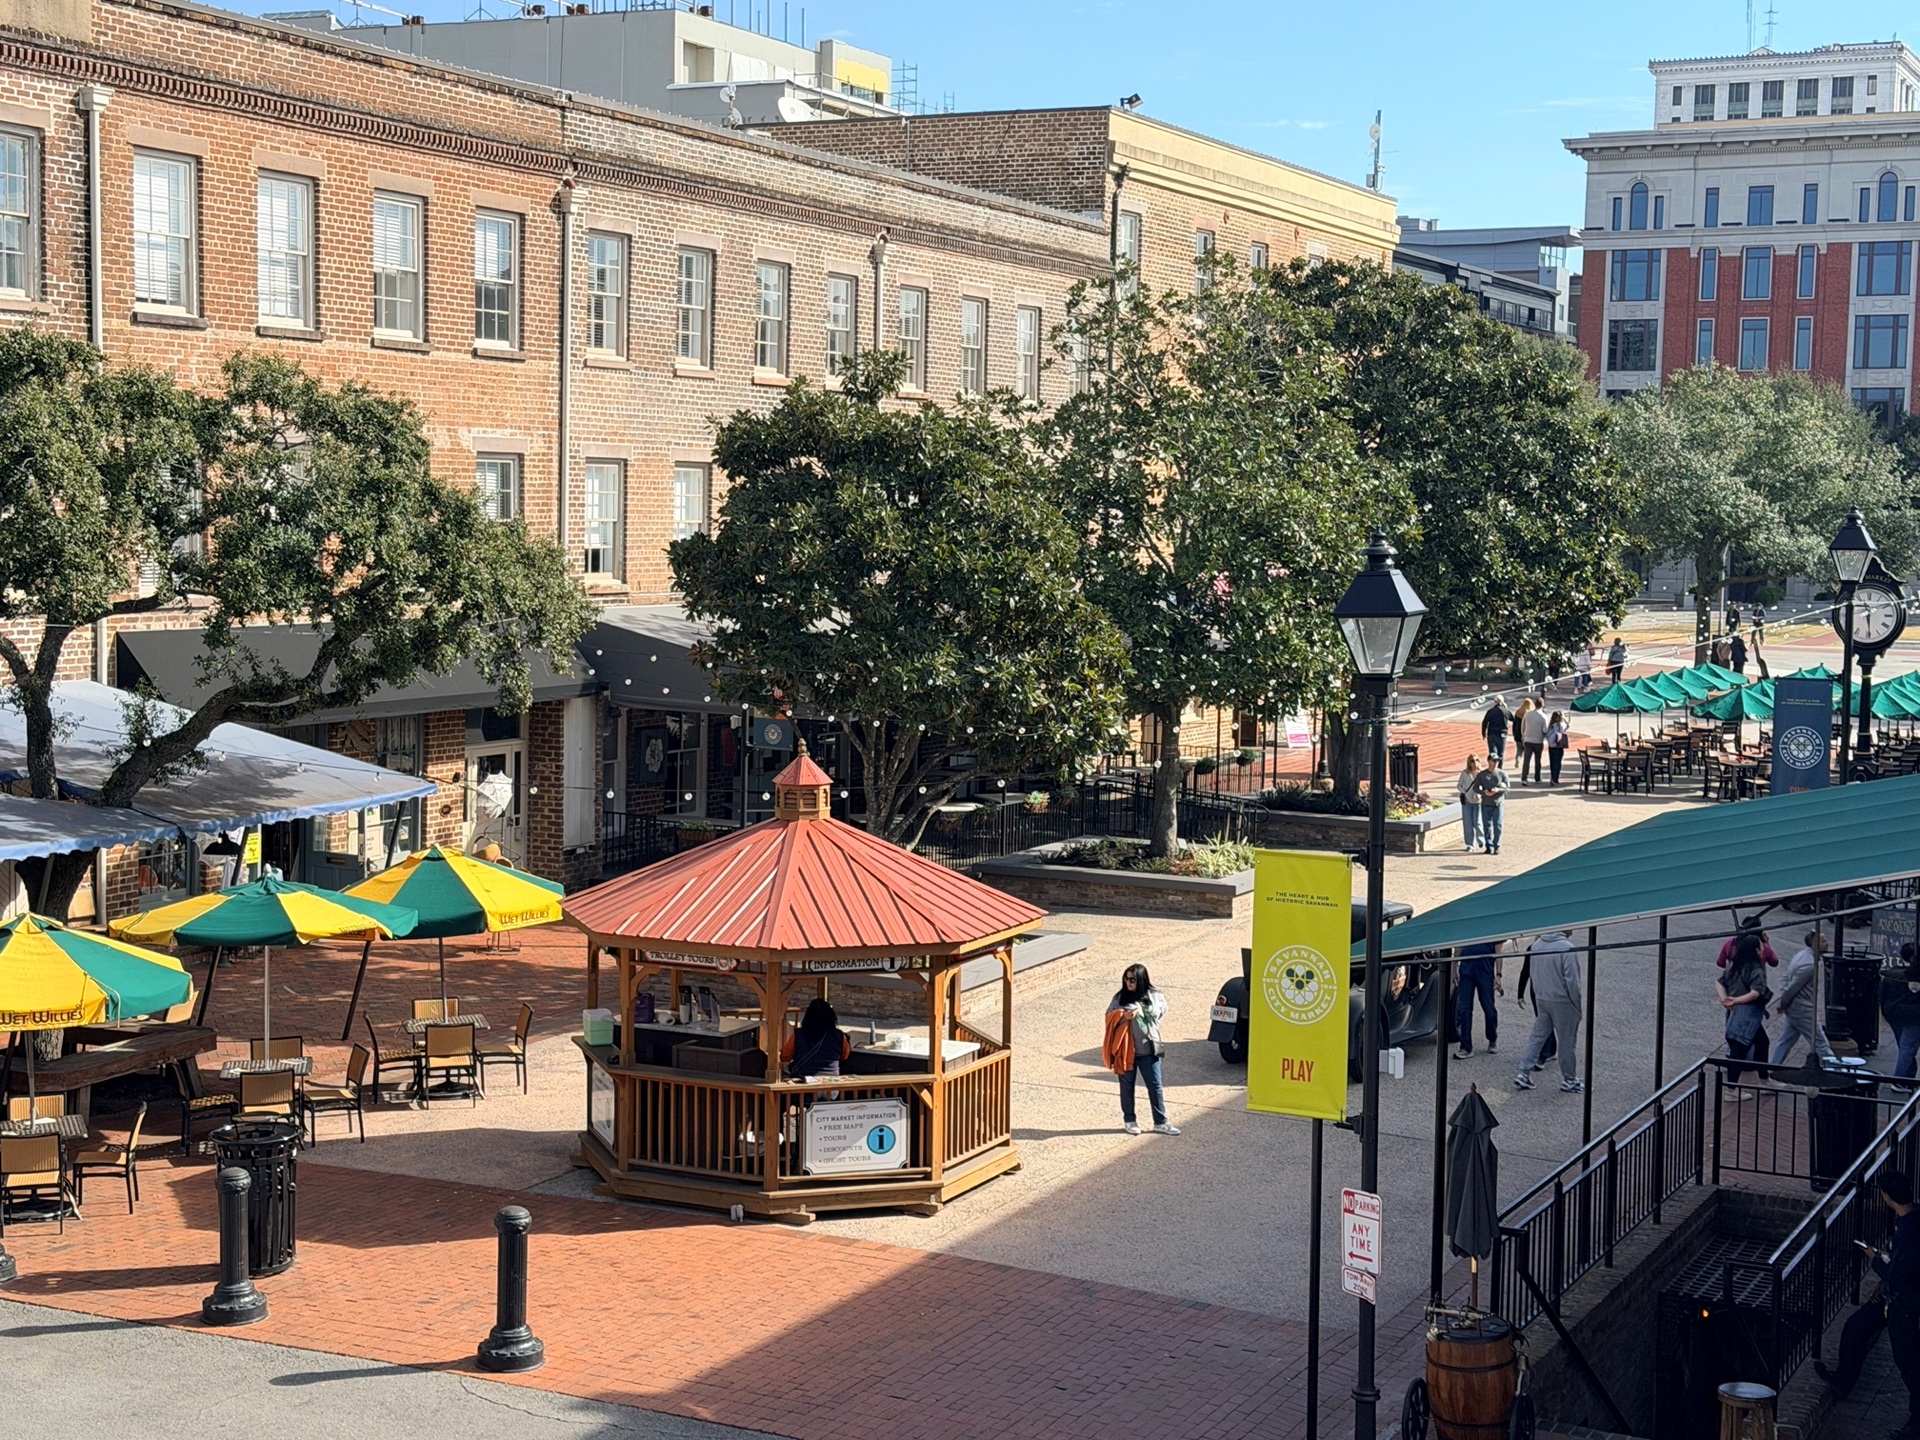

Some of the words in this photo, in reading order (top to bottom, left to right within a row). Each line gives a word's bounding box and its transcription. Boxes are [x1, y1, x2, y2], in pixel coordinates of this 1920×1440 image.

[650, 951, 685, 962] TROLLEY
[688, 954, 714, 964] TOURS
[814, 958, 879, 969] INFORMATION
[1270, 950, 1331, 979] SAVANNAH
[1268, 988, 1287, 1013] CITY
[1290, 994, 1331, 1020] MARKET
[1282, 1058, 1314, 1082] PLAY
[856, 1112, 896, 1121] INFORMATION
[823, 1145, 863, 1153] DISCOUNTS
[1344, 1194, 1354, 1210] NO
[1354, 1200, 1379, 1214] PARKING
[1352, 1222, 1370, 1237] ANY
[1350, 1236, 1372, 1252] TIME
[1353, 1283, 1368, 1294] ZONE
